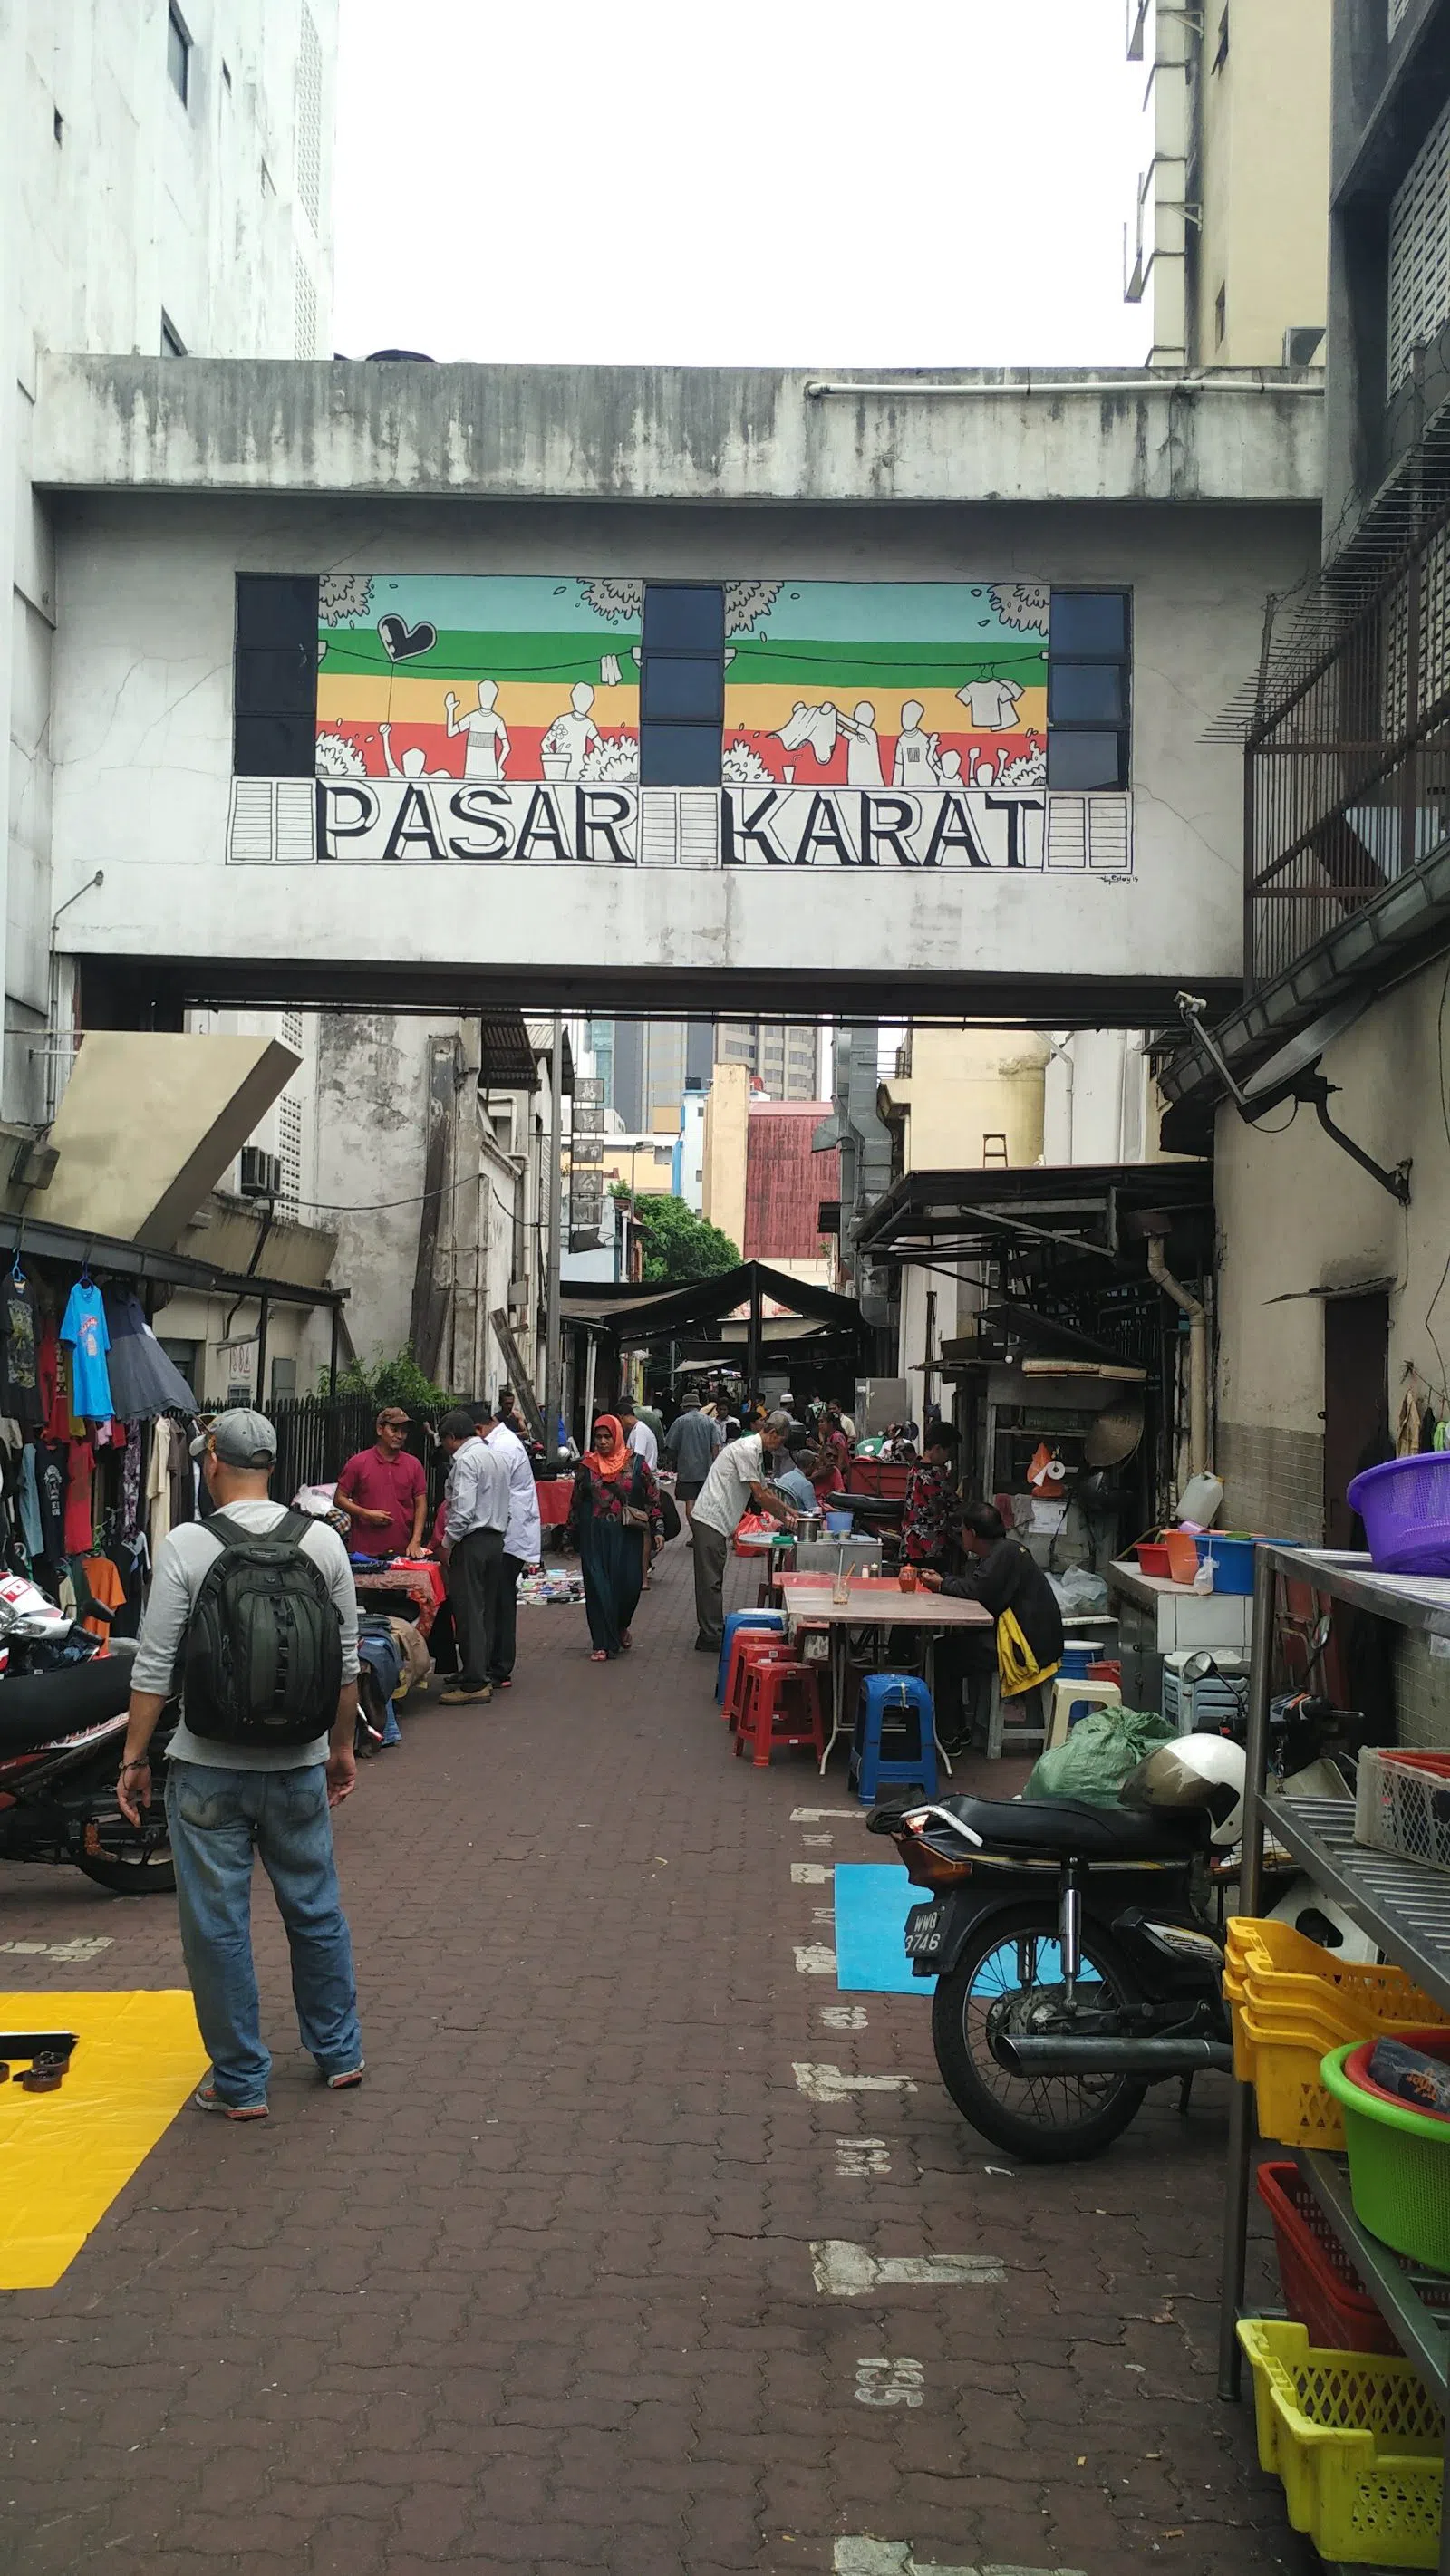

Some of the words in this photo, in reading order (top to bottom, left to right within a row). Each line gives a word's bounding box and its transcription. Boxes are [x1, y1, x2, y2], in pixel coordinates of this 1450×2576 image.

[316, 778, 637, 860] PASAR
[721, 787, 1045, 867] KARAT
[905, 1933, 941, 1952] 3746
